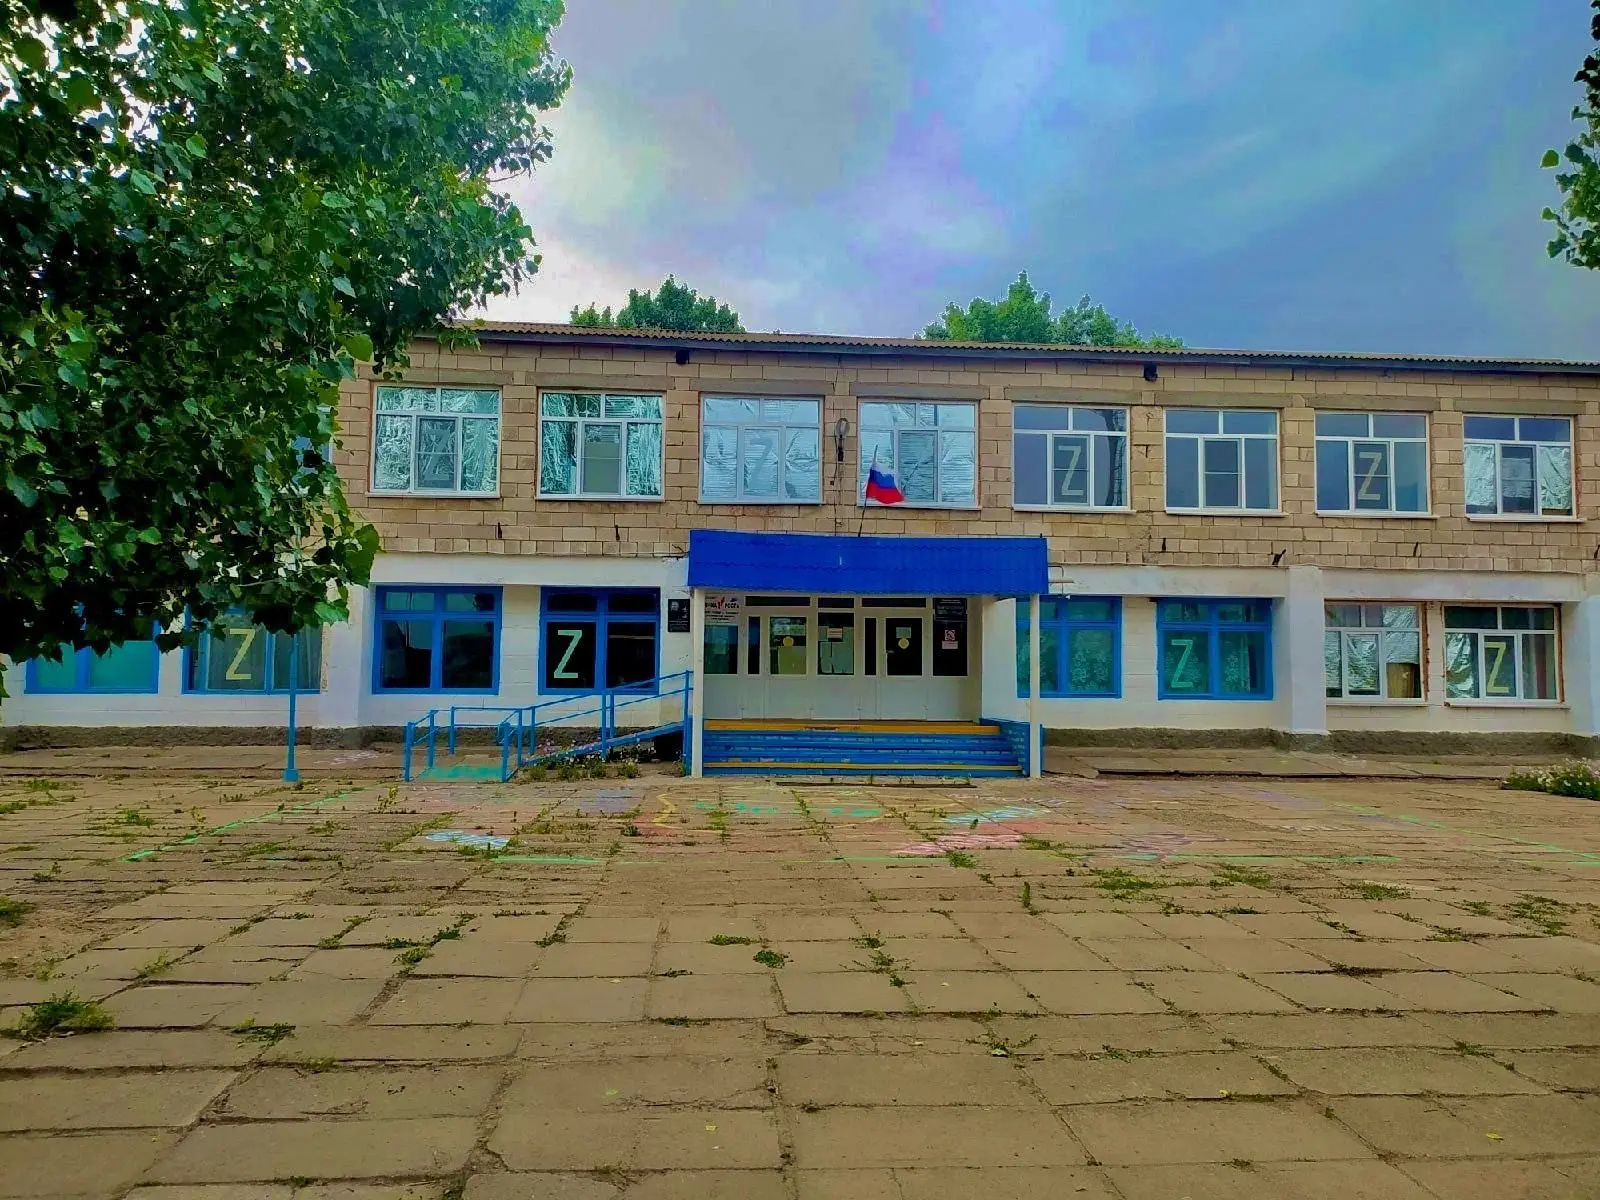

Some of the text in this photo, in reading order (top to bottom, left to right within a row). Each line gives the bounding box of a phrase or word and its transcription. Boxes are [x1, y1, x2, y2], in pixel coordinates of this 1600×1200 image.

[1058, 445, 1084, 496] Z
[1357, 451, 1383, 501] Z
[225, 628, 256, 680] Z
[553, 629, 583, 679] Z
[1171, 639, 1194, 689] Z
[1484, 641, 1510, 694] Z
